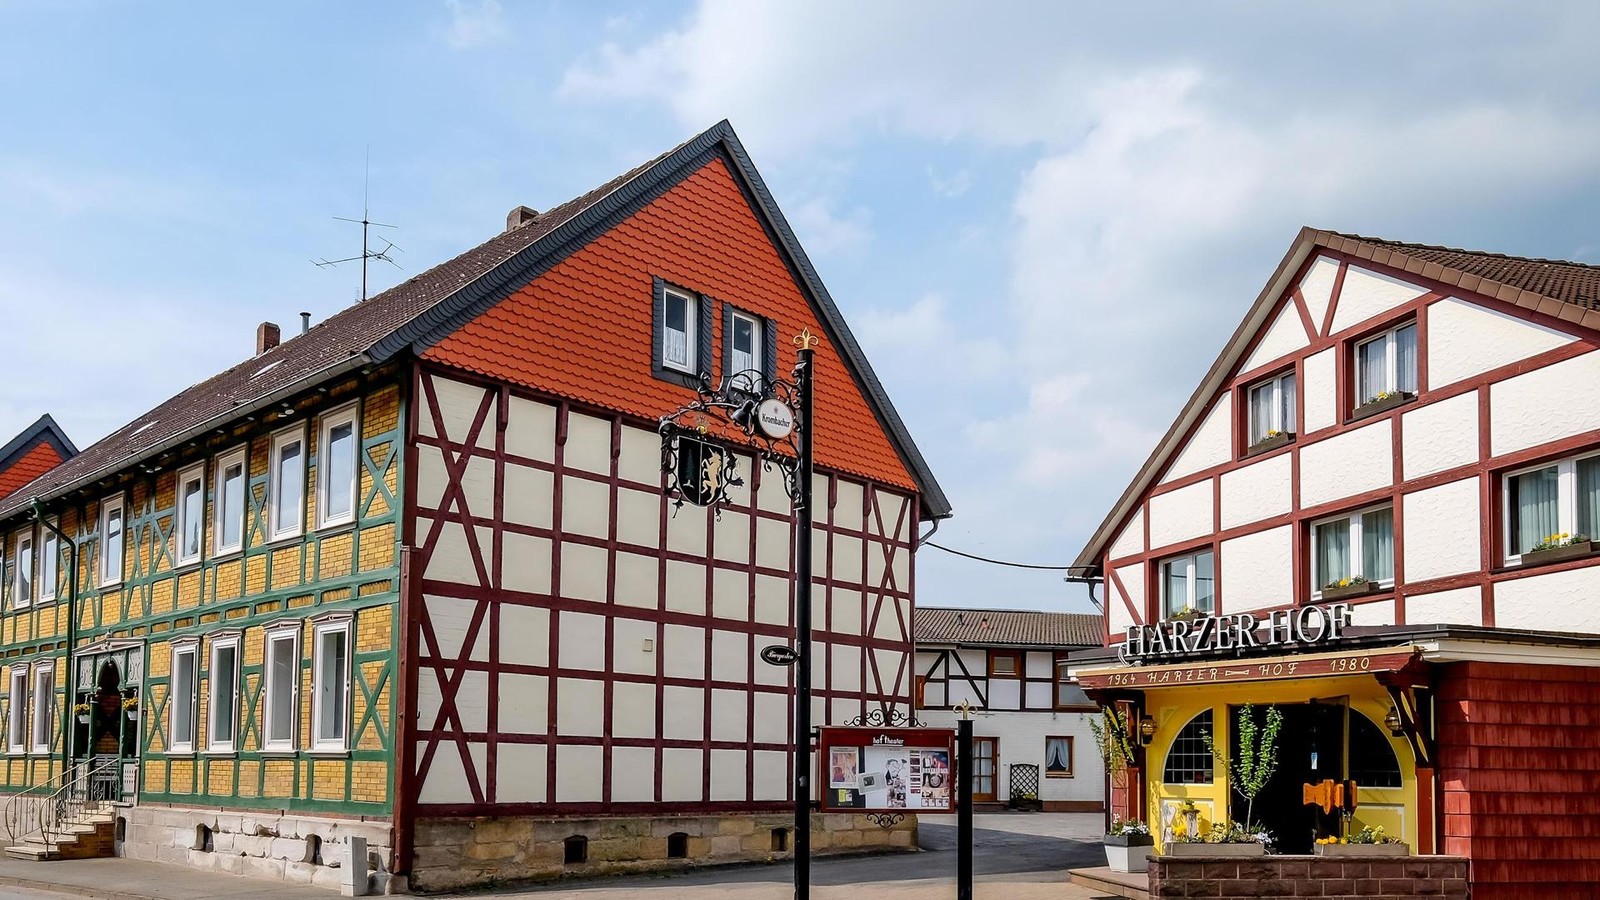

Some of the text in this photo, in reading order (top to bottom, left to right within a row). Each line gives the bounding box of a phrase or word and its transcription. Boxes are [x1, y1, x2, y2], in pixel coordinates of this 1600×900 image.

[761, 413, 791, 428] Krombacher
[1122, 603, 1353, 657] HARZER HOF
[1107, 657, 1371, 686] 1964 HARZER HOF 1980
